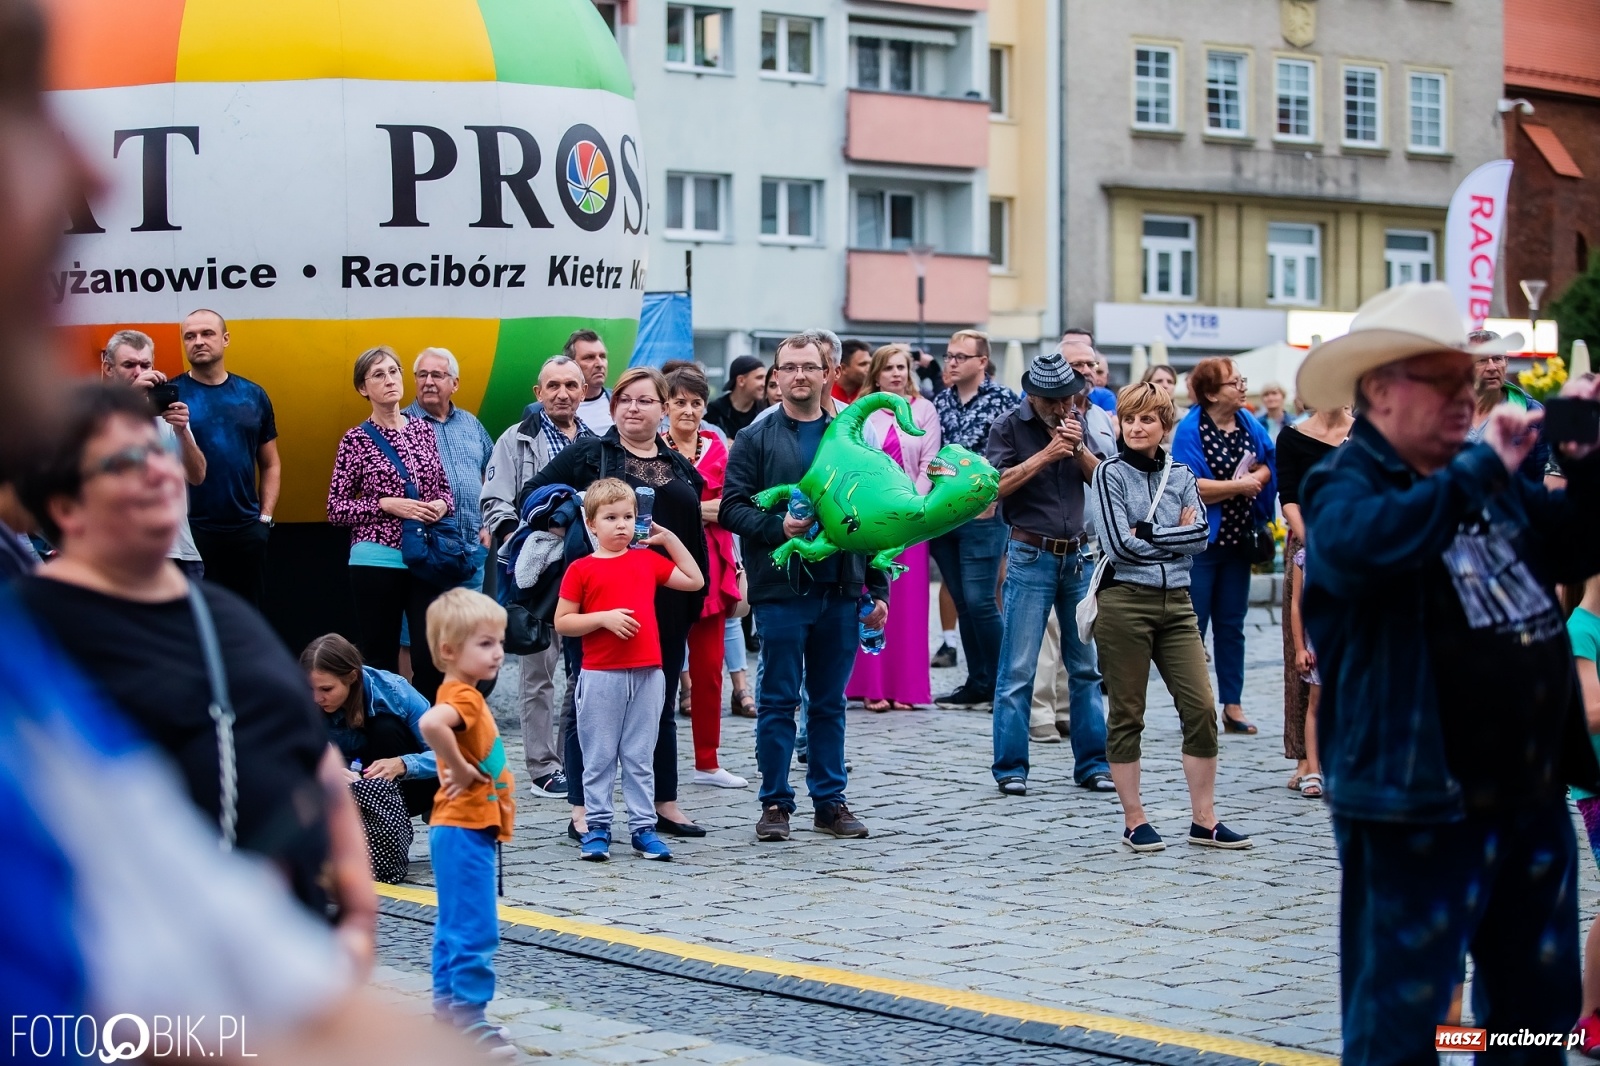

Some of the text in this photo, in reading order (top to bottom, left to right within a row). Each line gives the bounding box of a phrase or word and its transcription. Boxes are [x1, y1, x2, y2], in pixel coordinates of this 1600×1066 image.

[375, 123, 649, 235] PROS
[50, 257, 277, 304] yżanowice
[341, 254, 527, 289] Racibórz
[547, 255, 623, 290] Kietrz
[1470, 194, 1494, 331] RACIB
